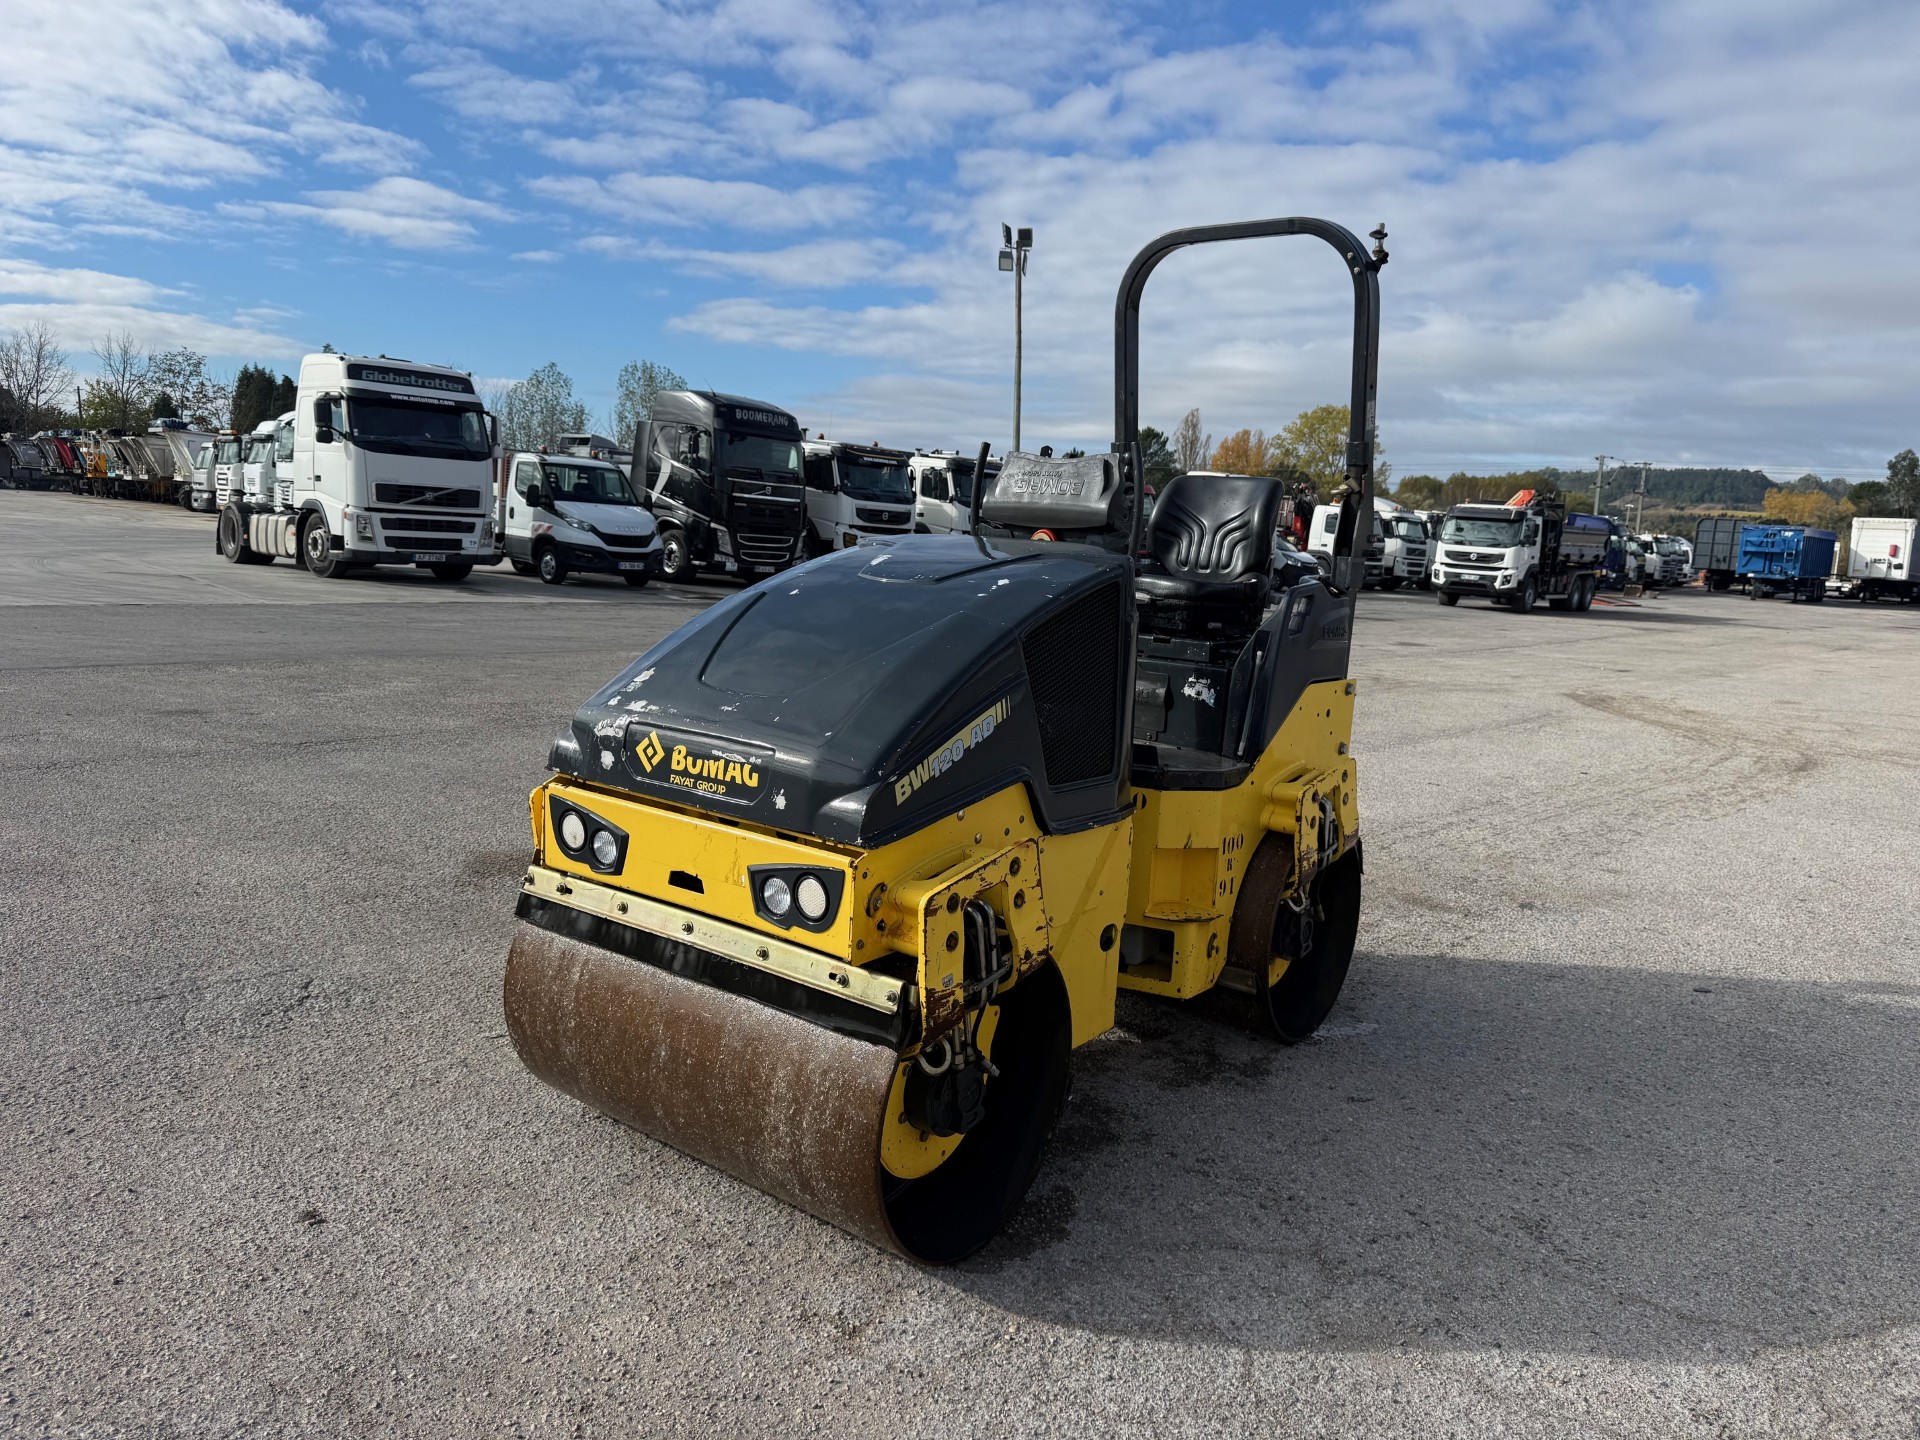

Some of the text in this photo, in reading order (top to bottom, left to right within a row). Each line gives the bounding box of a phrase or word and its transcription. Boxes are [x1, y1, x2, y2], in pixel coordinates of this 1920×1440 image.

[361, 369, 465, 391] Globetrotter
[735, 408, 789, 426] BOOMERANG
[1015, 479, 1086, 496] BOMAG
[970, 714, 996, 749] AD
[669, 774, 726, 795] FAYAT GROUP
[1222, 833, 1244, 855] 100
[1219, 877, 1234, 897] 91
